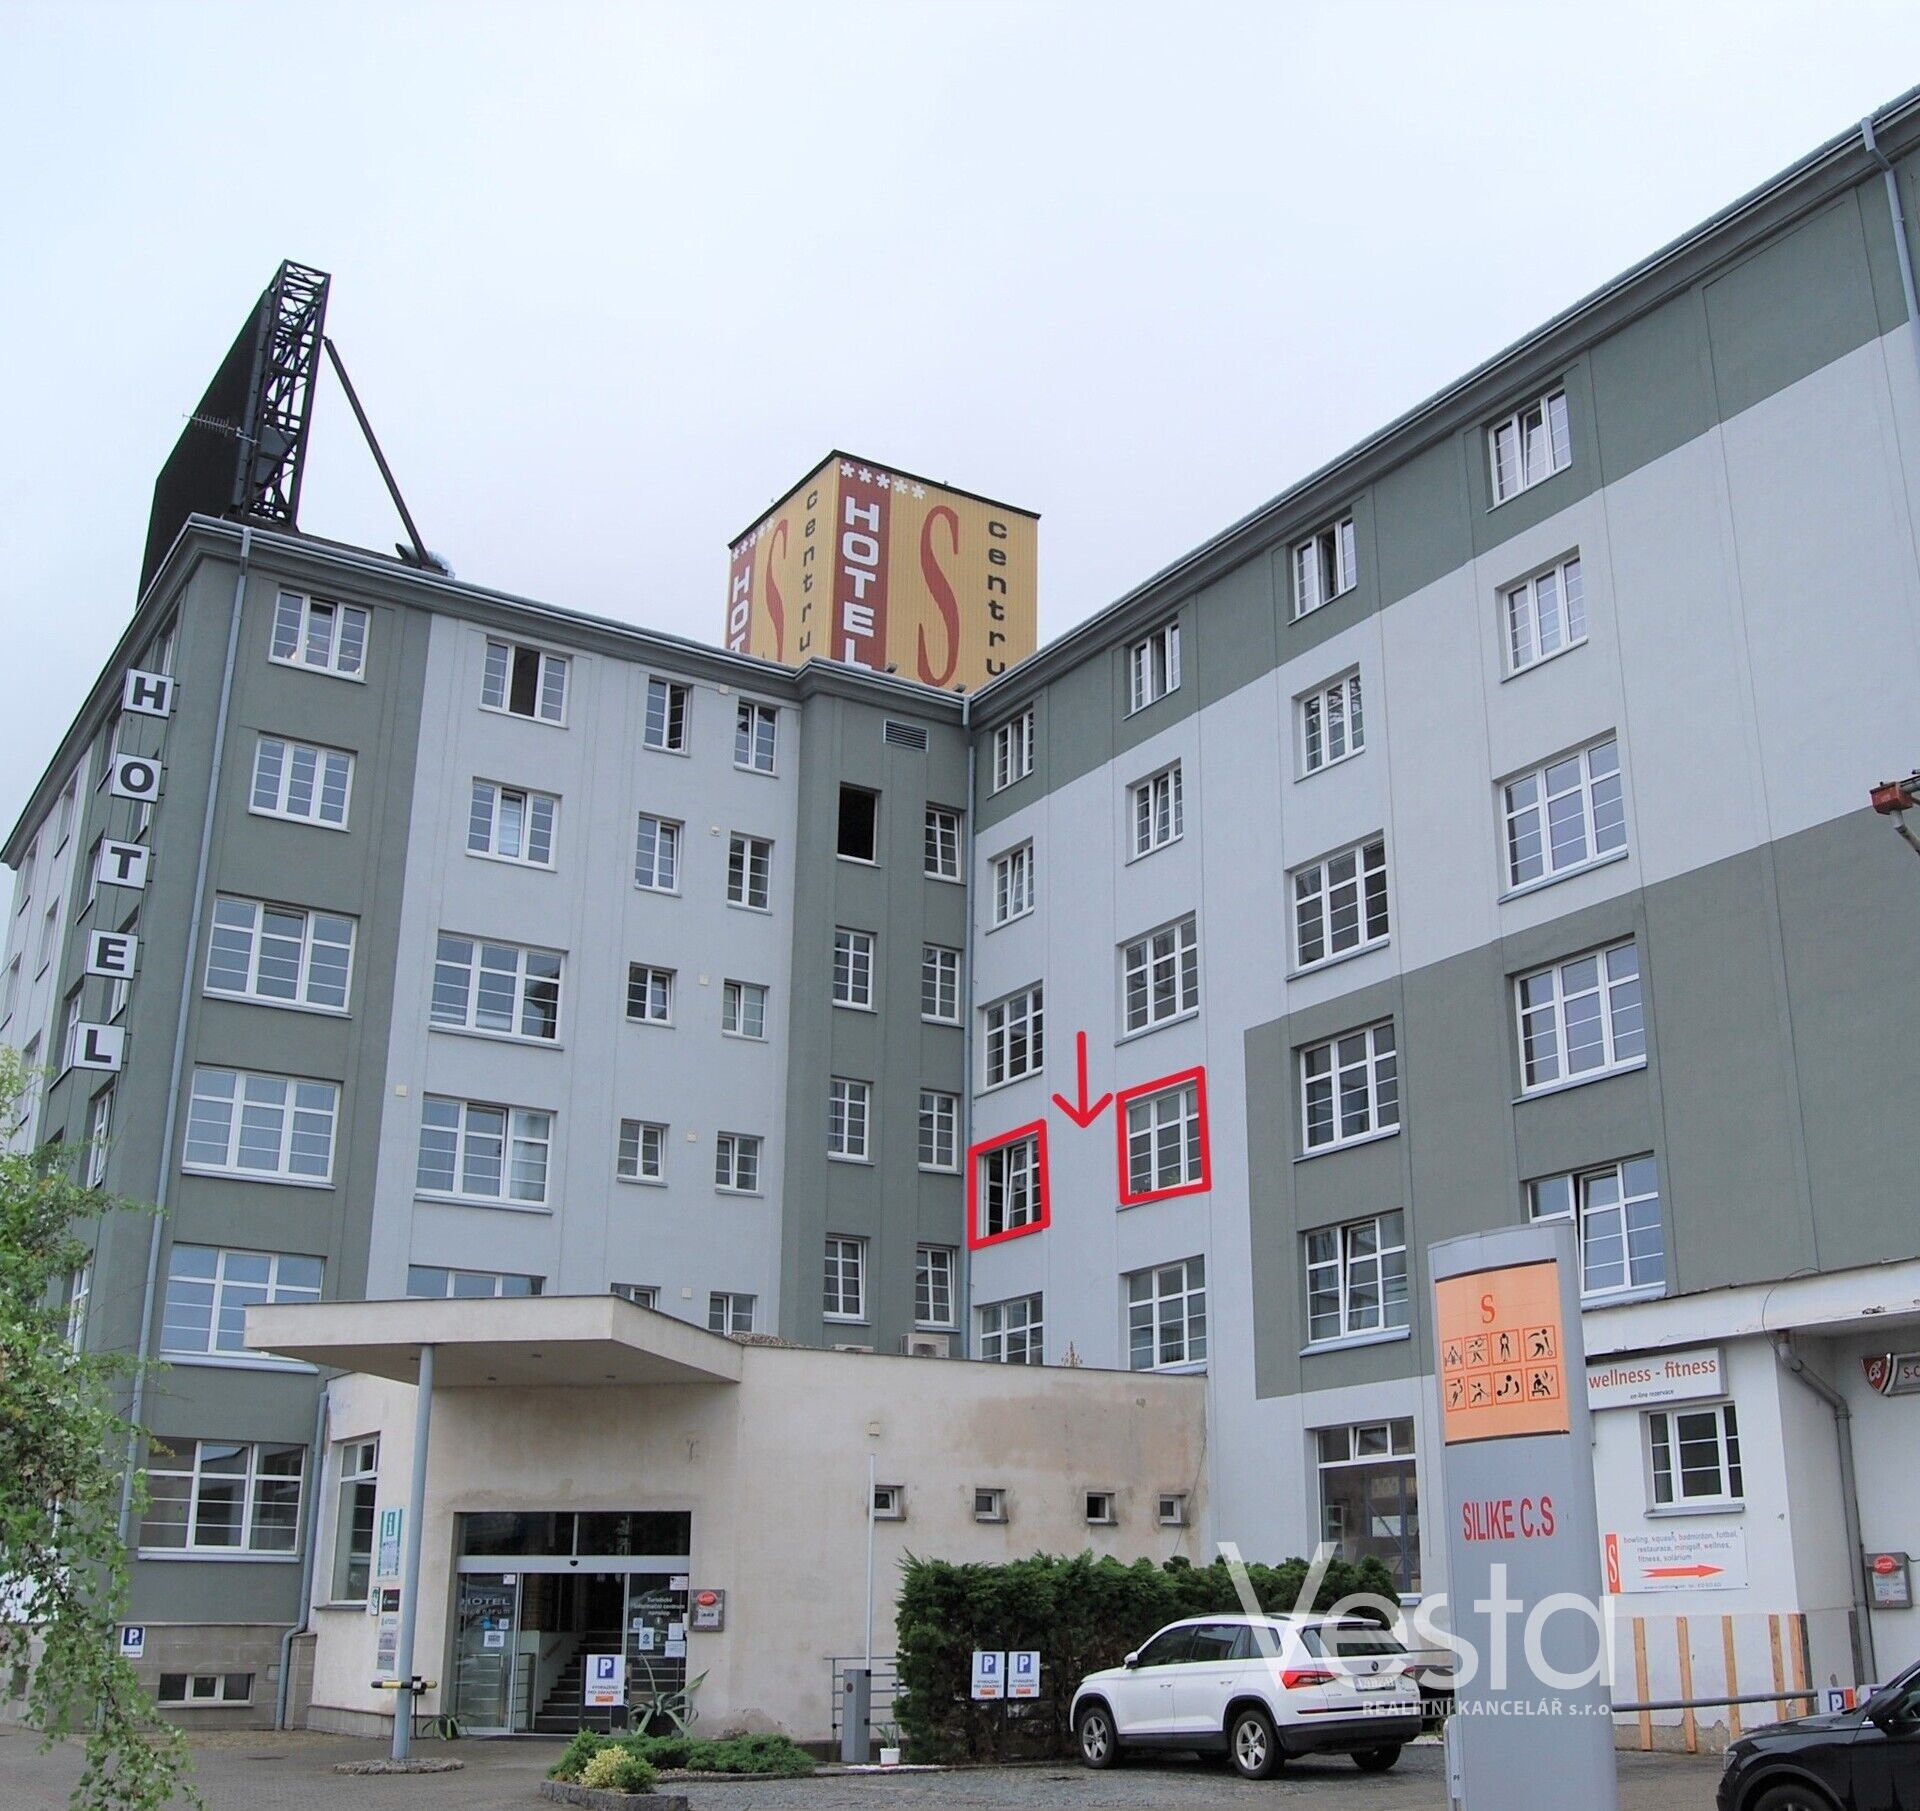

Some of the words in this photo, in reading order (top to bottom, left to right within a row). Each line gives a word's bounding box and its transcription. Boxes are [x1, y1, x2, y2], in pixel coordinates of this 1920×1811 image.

[842, 495, 880, 671] HOTEL
[917, 504, 960, 687] S
[83, 676, 168, 1064] HOTEL
[1480, 1294, 1496, 1325] S
[1588, 1368, 1651, 1389] wellness
[1664, 1359, 1717, 1379] fitness
[1462, 1499, 1515, 1541] SILIKE
[1520, 1496, 1556, 1539] C.S
[1607, 1543, 1618, 1584] S
[128, 1628, 140, 1645] P
[600, 1658, 613, 1677] P
[984, 1655, 994, 1673] P
[1019, 1655, 1030, 1672] P
